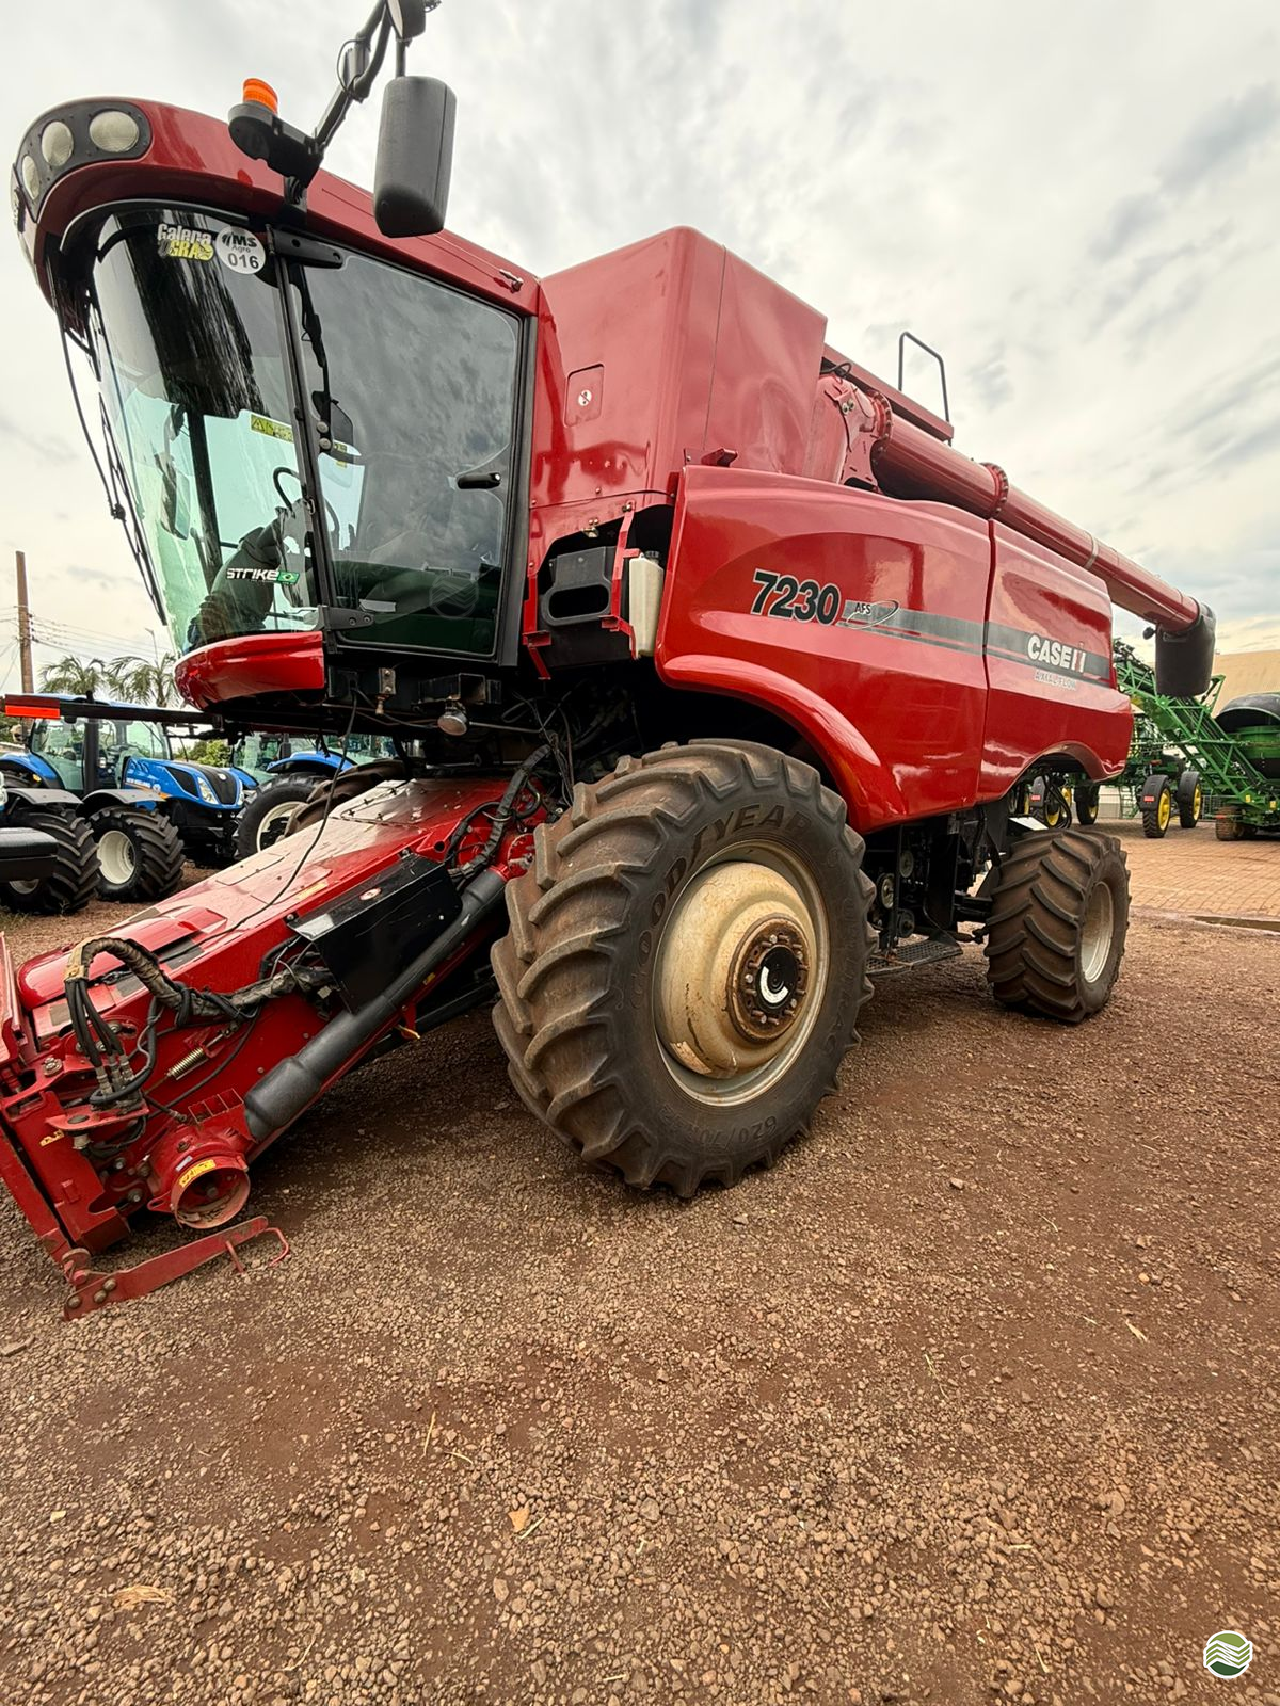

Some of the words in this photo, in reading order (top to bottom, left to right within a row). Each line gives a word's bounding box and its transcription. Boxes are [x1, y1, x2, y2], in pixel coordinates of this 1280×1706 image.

[227, 253, 259, 270] 016
[750, 567, 841, 626] 7230
[855, 602, 871, 615] AFS
